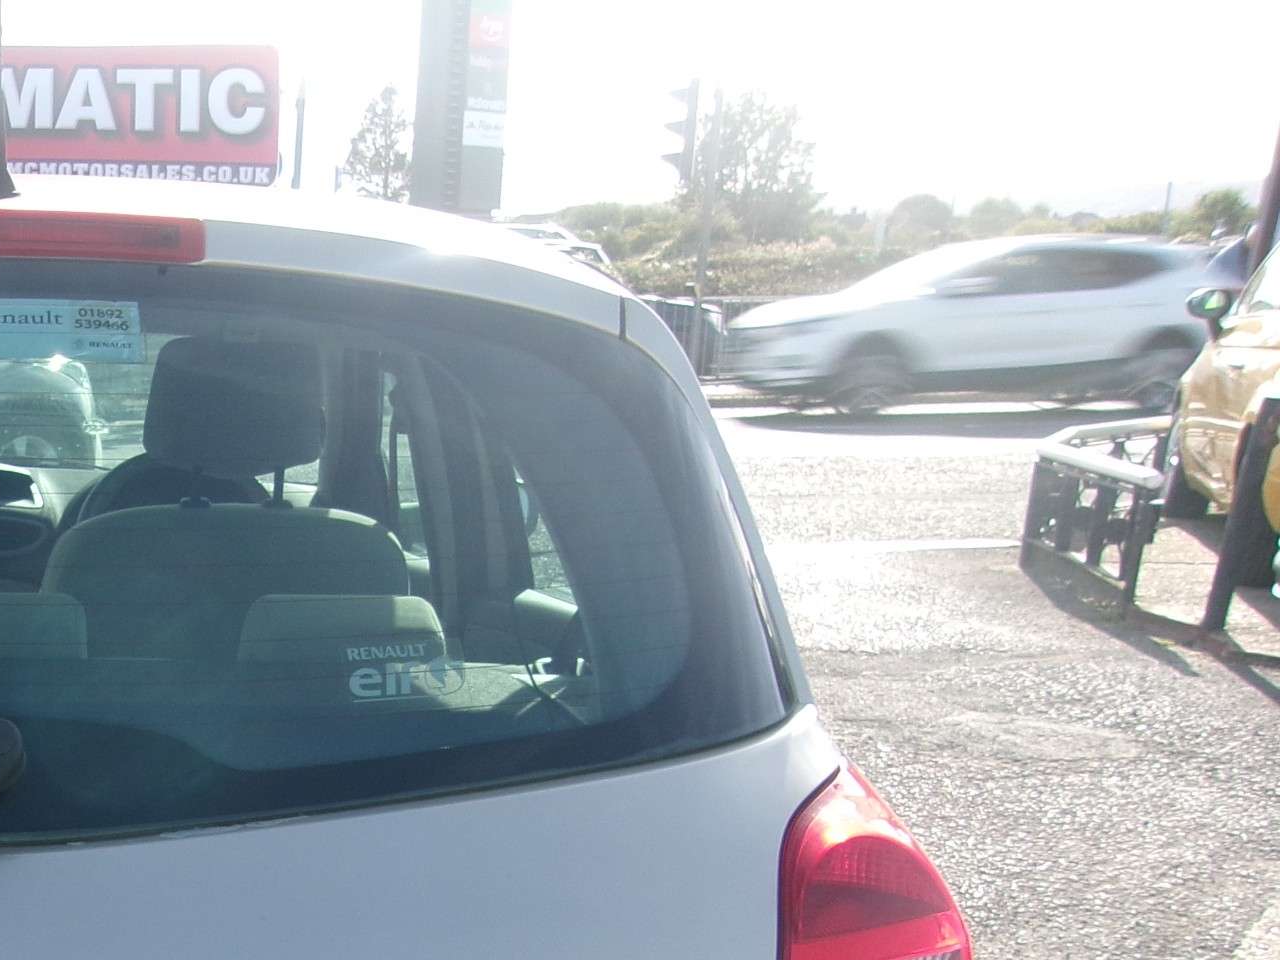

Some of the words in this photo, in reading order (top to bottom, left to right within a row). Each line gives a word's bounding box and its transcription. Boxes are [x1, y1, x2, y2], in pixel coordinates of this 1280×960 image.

[6, 160, 271, 184] MCMOTORSALES.CO.UK
[78, 308, 124, 319] 01892
[88, 341, 132, 349] RENAULT
[346, 643, 427, 662] RENAULT
